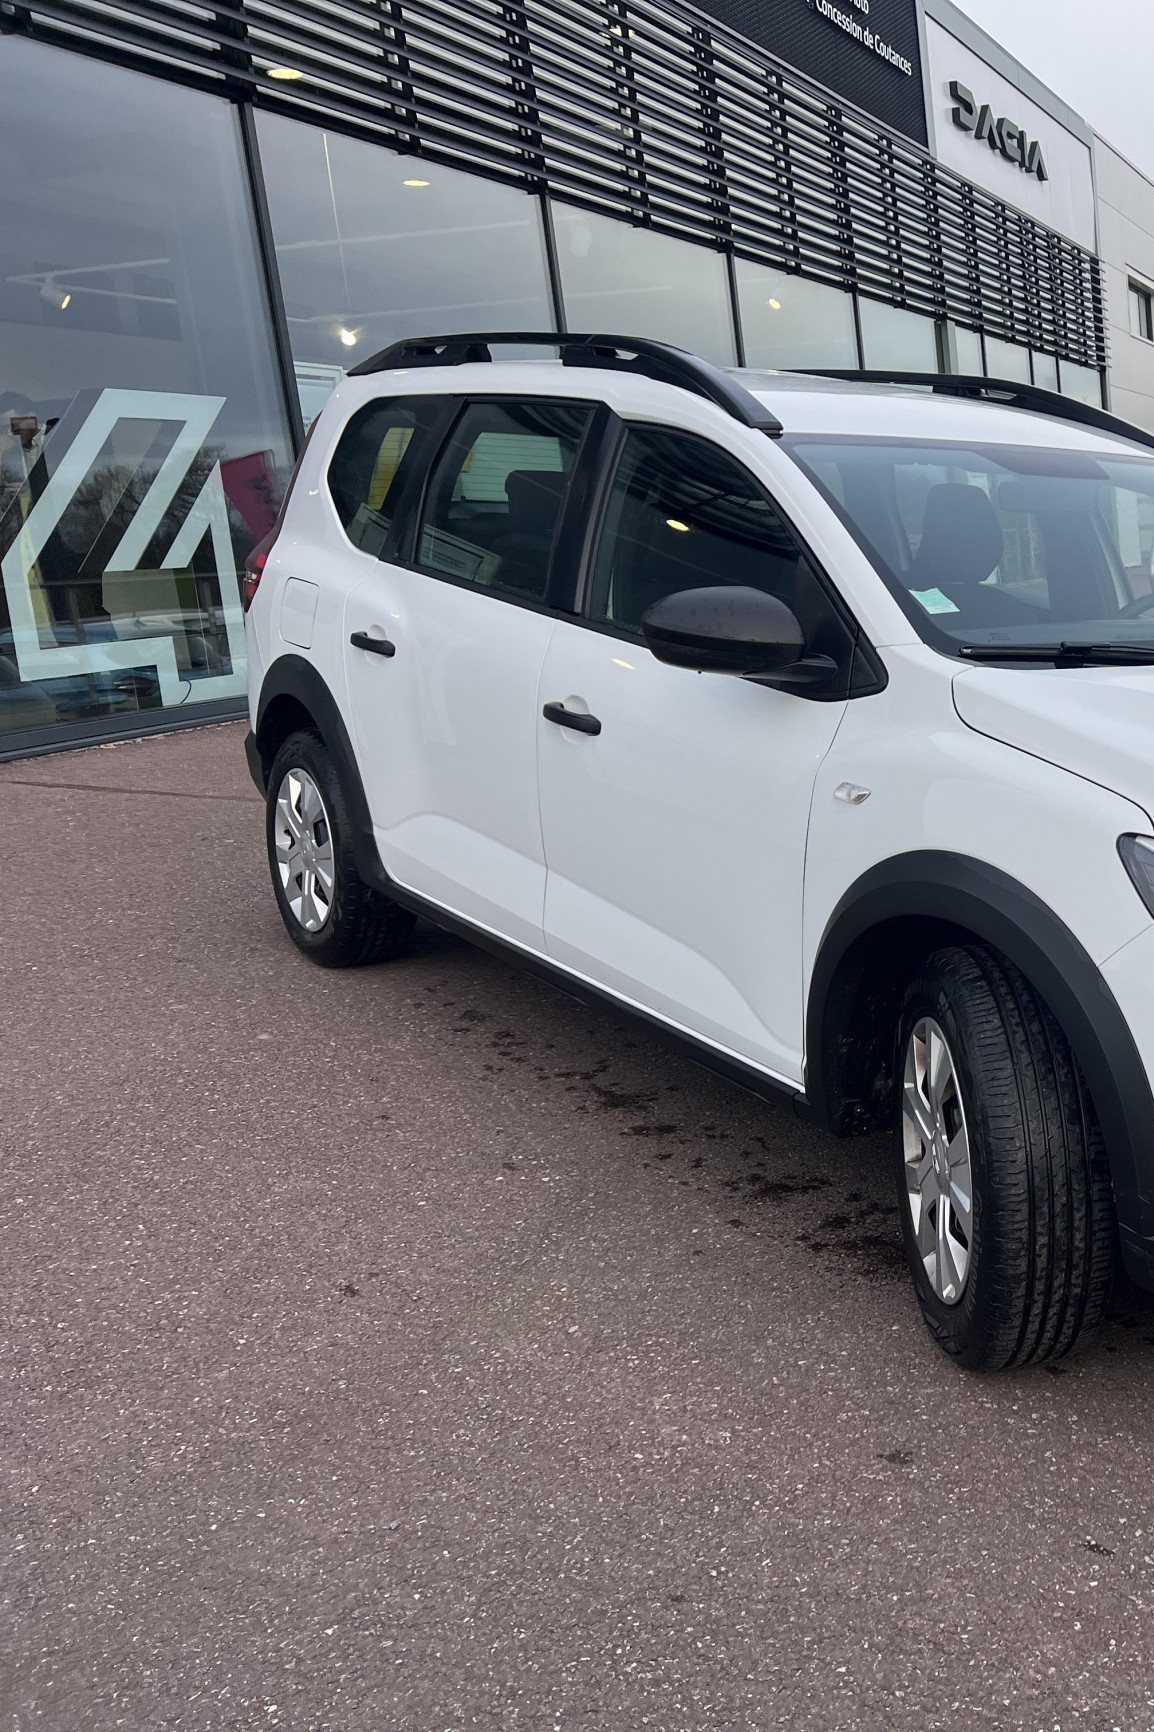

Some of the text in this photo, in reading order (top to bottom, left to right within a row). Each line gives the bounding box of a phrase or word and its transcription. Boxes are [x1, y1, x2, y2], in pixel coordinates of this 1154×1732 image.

[816, 0, 912, 76] Concession de Coutances
[949, 81, 1049, 181] DACIA
